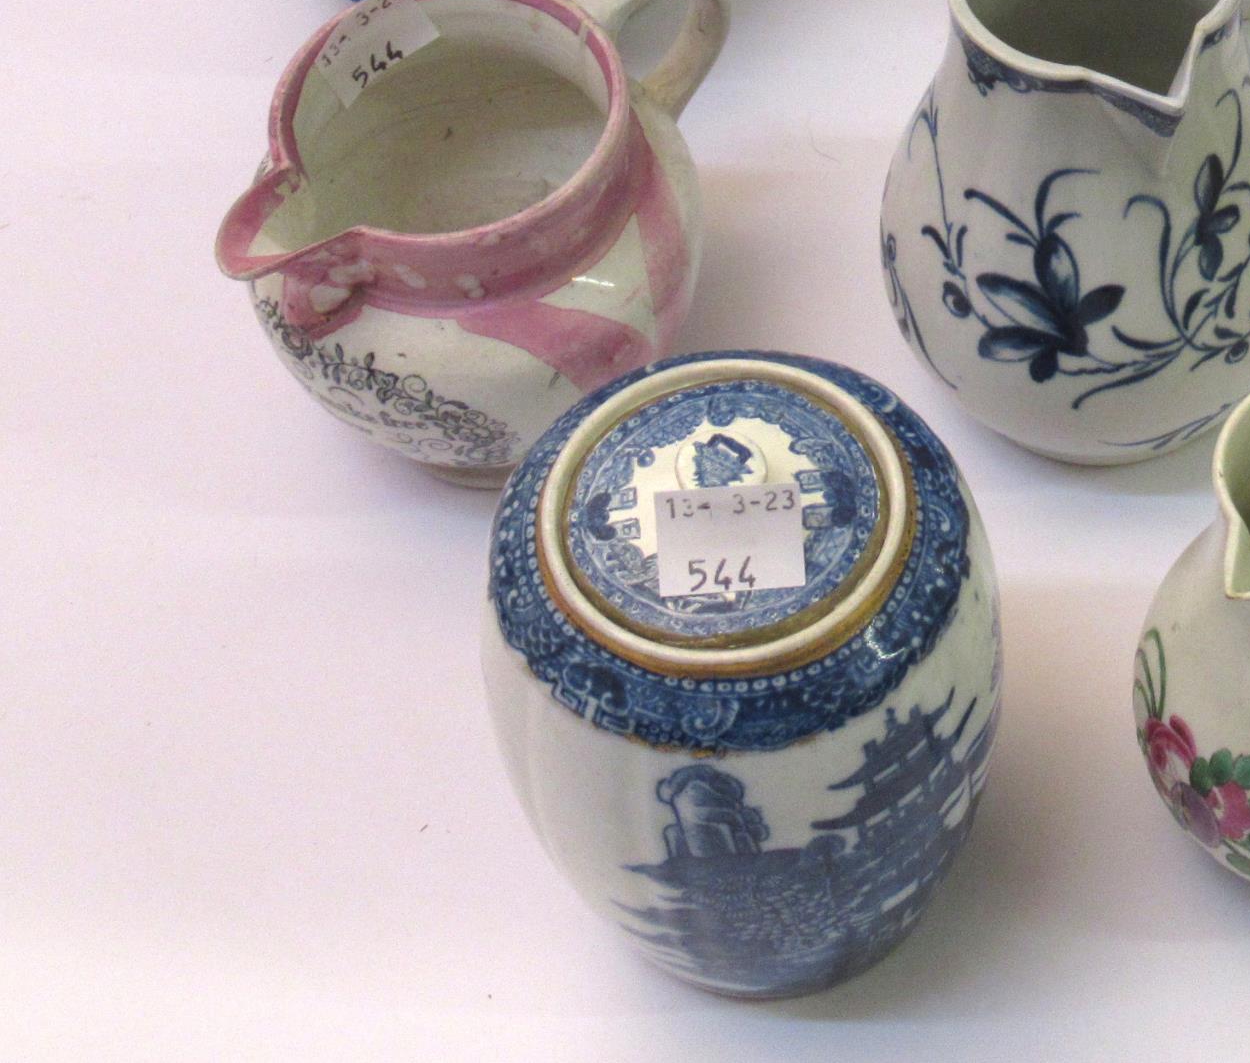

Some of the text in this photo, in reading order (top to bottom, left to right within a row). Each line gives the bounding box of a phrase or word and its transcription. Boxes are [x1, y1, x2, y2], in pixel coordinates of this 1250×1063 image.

[352, 40, 404, 89] 544
[732, 489, 796, 515] 3-23
[688, 555, 756, 592] 544
